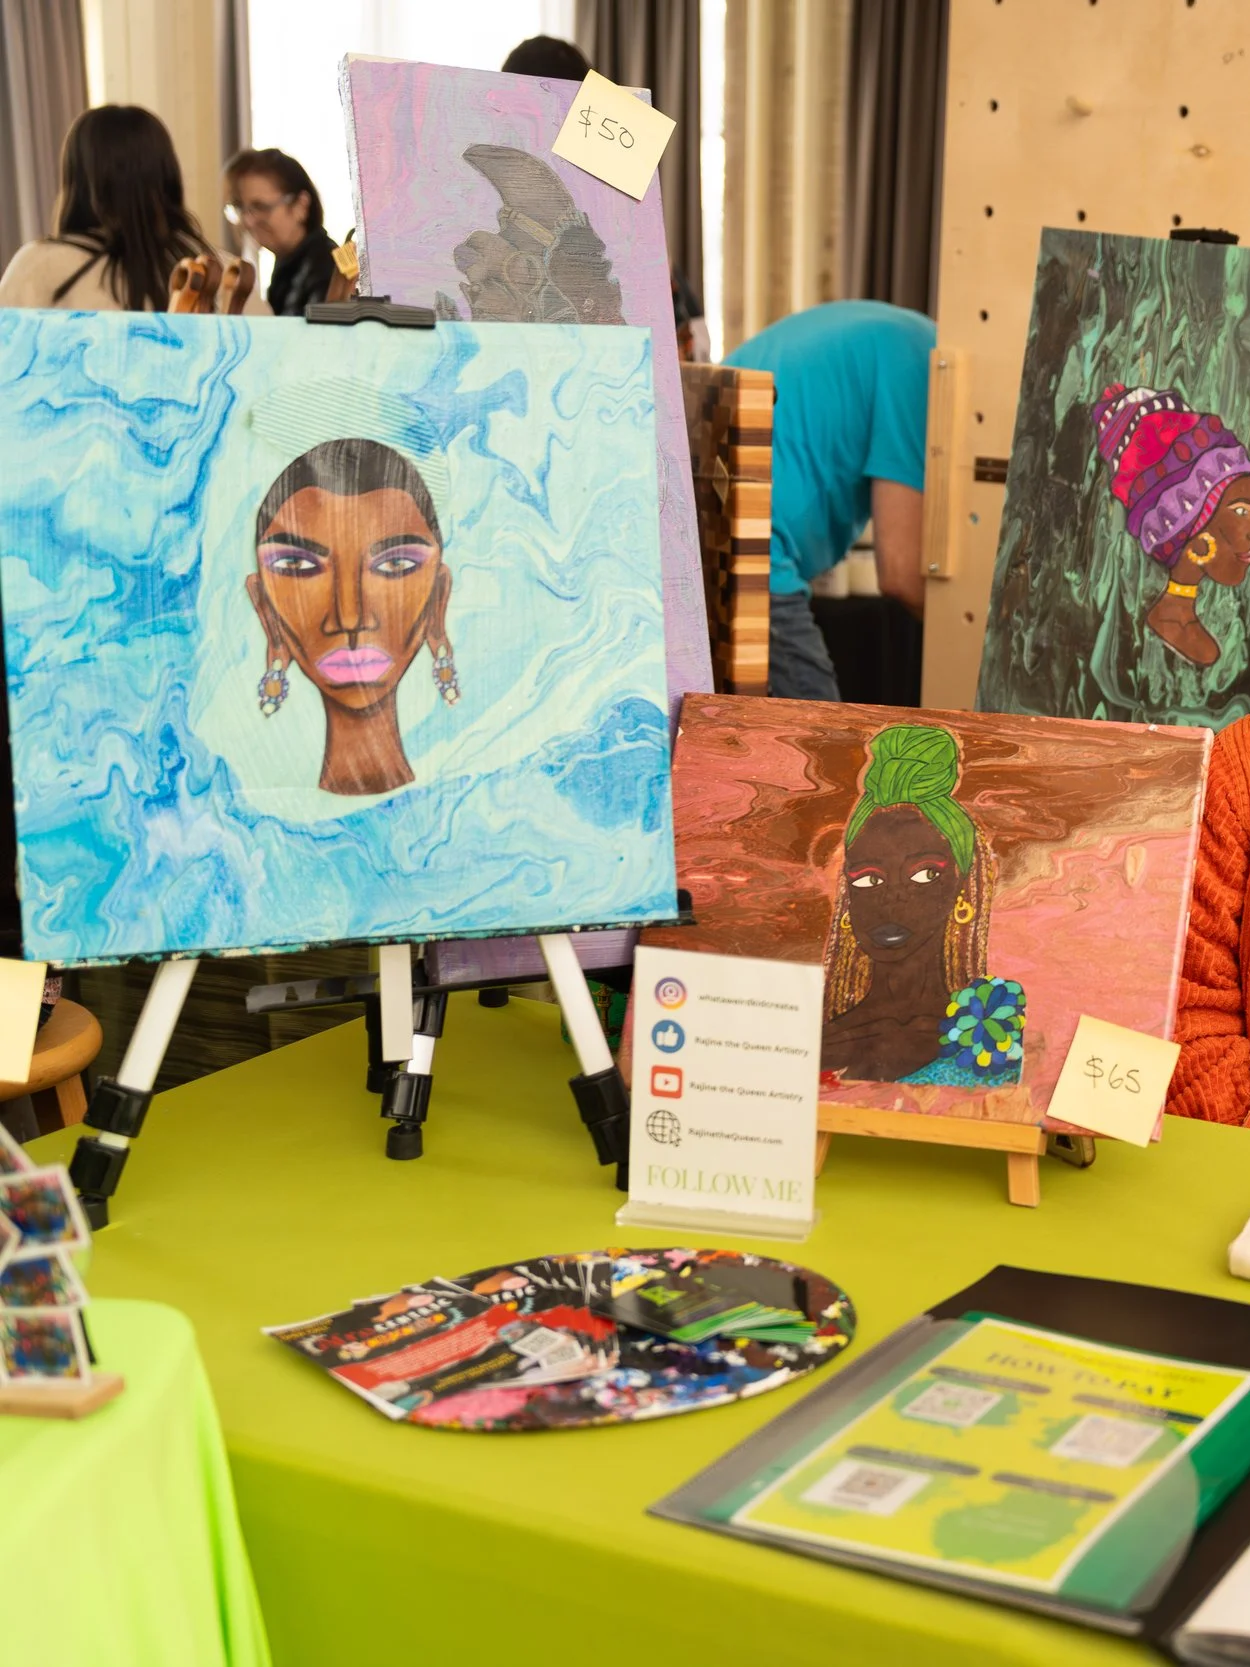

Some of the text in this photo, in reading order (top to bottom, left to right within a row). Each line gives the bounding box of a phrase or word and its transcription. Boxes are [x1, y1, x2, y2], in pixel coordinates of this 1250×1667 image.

[578, 105, 635, 149] $50
[695, 1036, 809, 1058] Rajine the Queen Artistry
[689, 1081, 803, 1103] Rajine the Queen Artistry
[1083, 1055, 1141, 1094] $65
[688, 1127, 783, 1145] RajinetheQueen.com
[647, 1165, 804, 1203] FOLLOW ME
[986, 1352, 1057, 1376] HOW
[1072, 1369, 1111, 1387] TO
[1115, 1378, 1184, 1399] PAY
